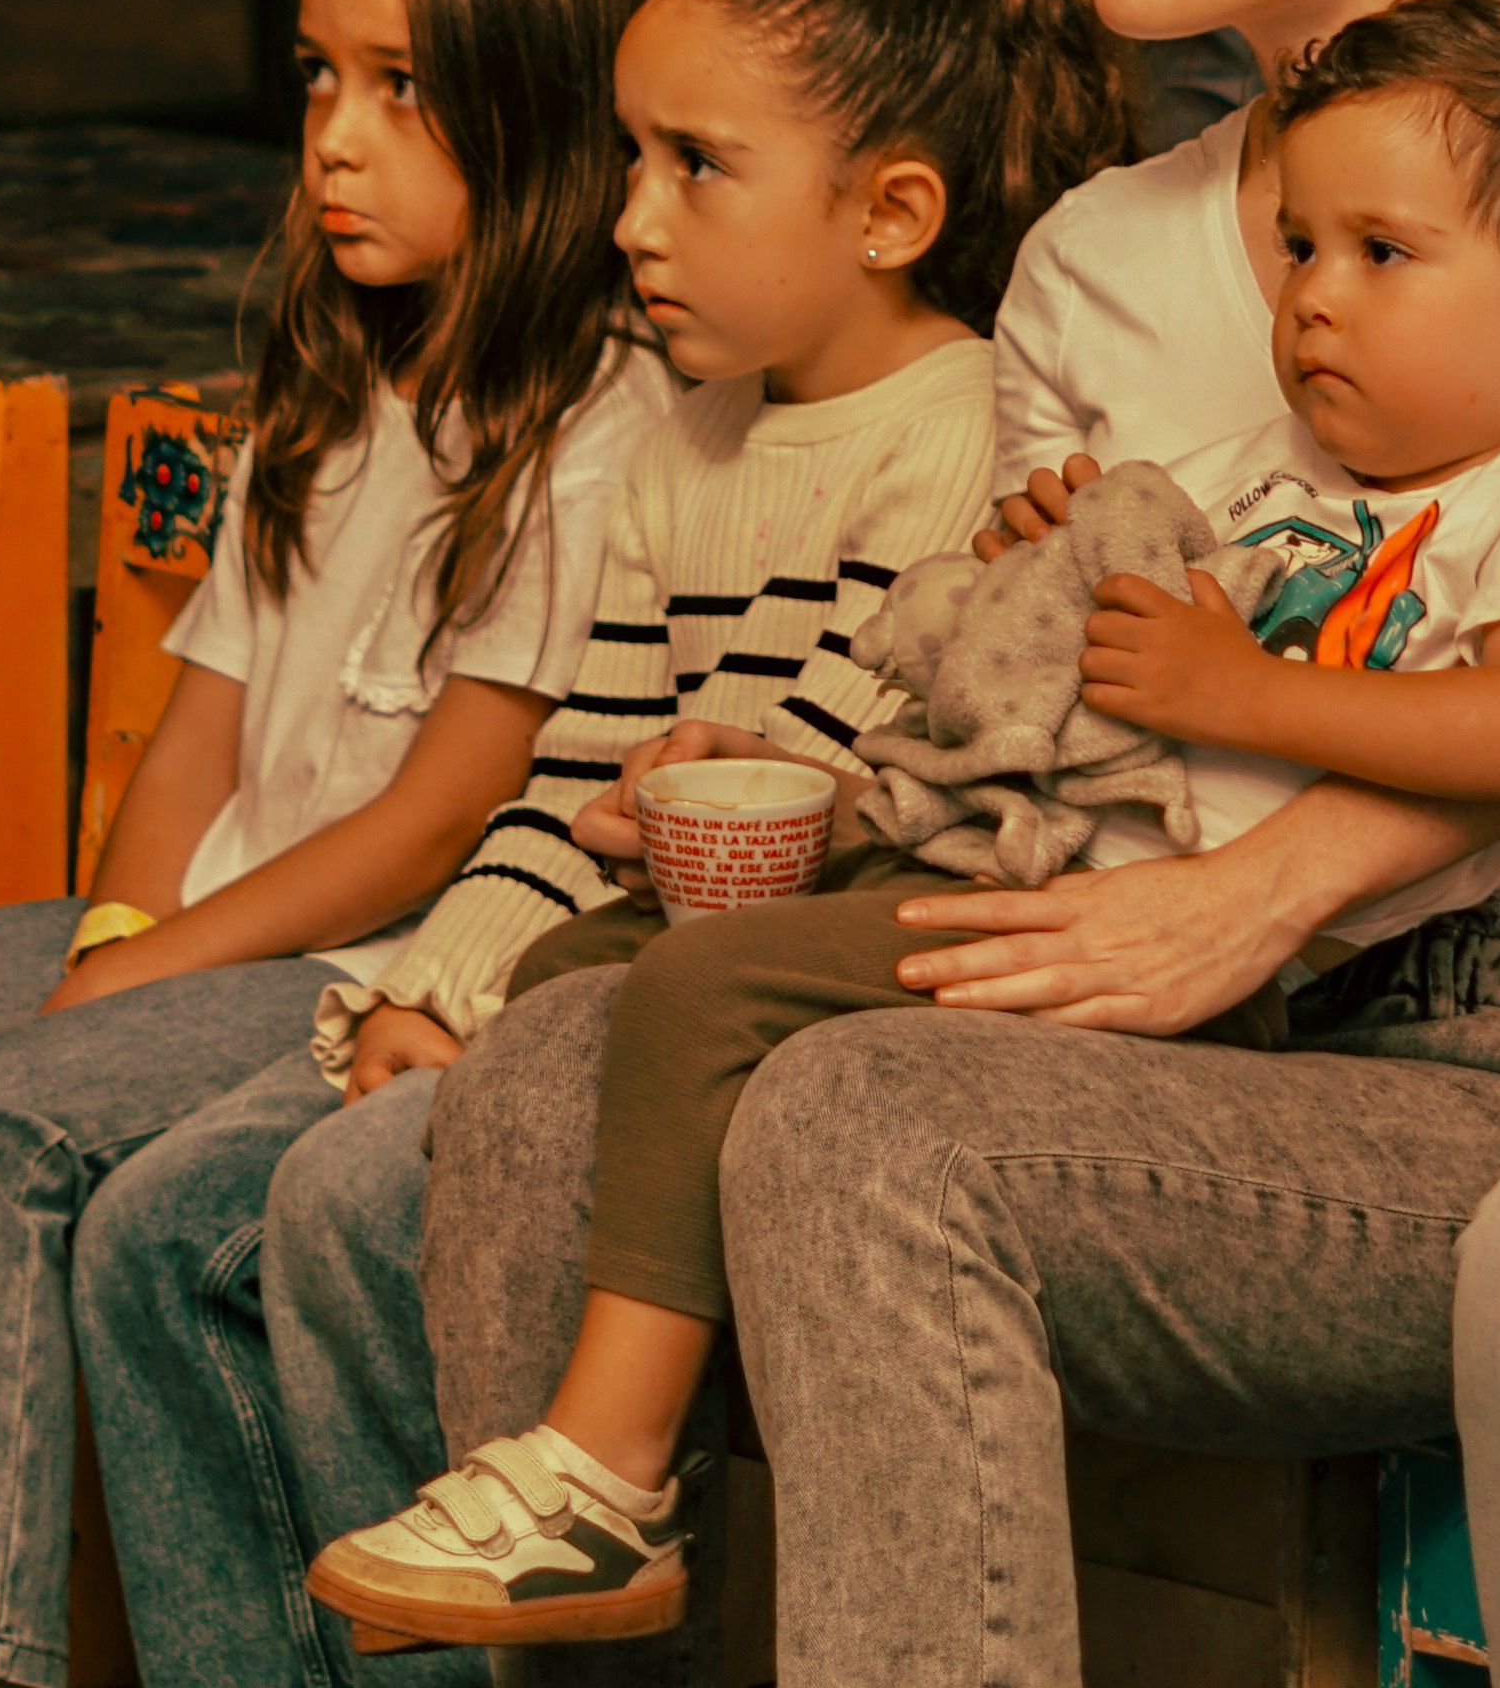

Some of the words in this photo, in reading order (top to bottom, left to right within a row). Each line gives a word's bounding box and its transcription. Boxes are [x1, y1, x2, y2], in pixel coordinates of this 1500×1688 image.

[668, 814, 699, 828] PARA
[703, 820, 722, 830] UN
[728, 818, 761, 831] CAFÉ
[766, 811, 823, 830] EXPRESSO
[669, 828, 697, 842] ESTA
[702, 833, 717, 844] ES
[722, 835, 739, 845] LA
[744, 835, 775, 845] TAZA
[780, 830, 809, 844] PARA
[728, 850, 754, 860] QUE
[763, 847, 791, 859] VALE
[716, 863, 733, 873] EN
[740, 863, 762, 873] ESE
[769, 859, 799, 872] CASO
[677, 871, 706, 883] PARA
[710, 876, 727, 885] UN
[737, 888, 765, 898] ESTA
